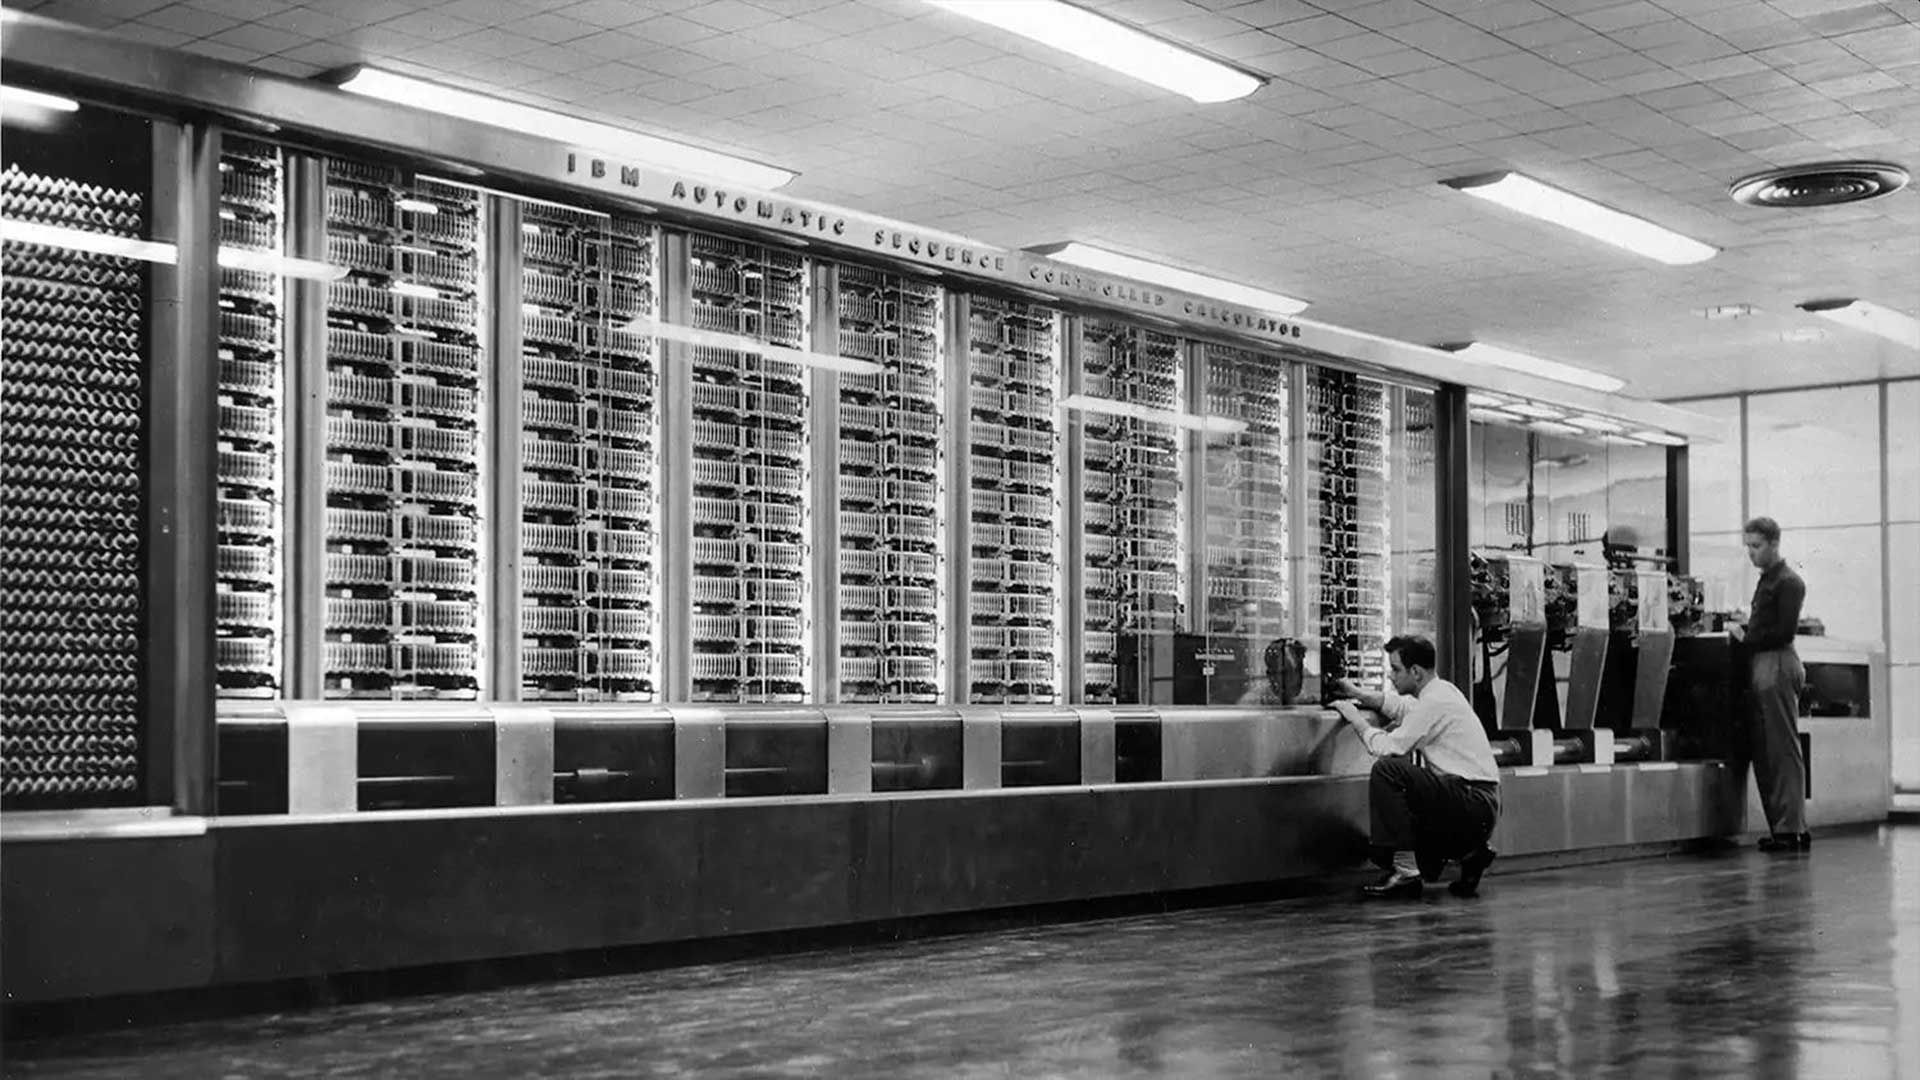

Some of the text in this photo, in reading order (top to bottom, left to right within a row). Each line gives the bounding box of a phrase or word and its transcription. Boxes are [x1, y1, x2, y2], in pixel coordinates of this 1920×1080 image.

[567, 153, 640, 187] IBM
[672, 181, 845, 235] AUTOMATIC
[874, 230, 1006, 271] SEQUENCE
[1184, 301, 1301, 338] CALCULATOR
